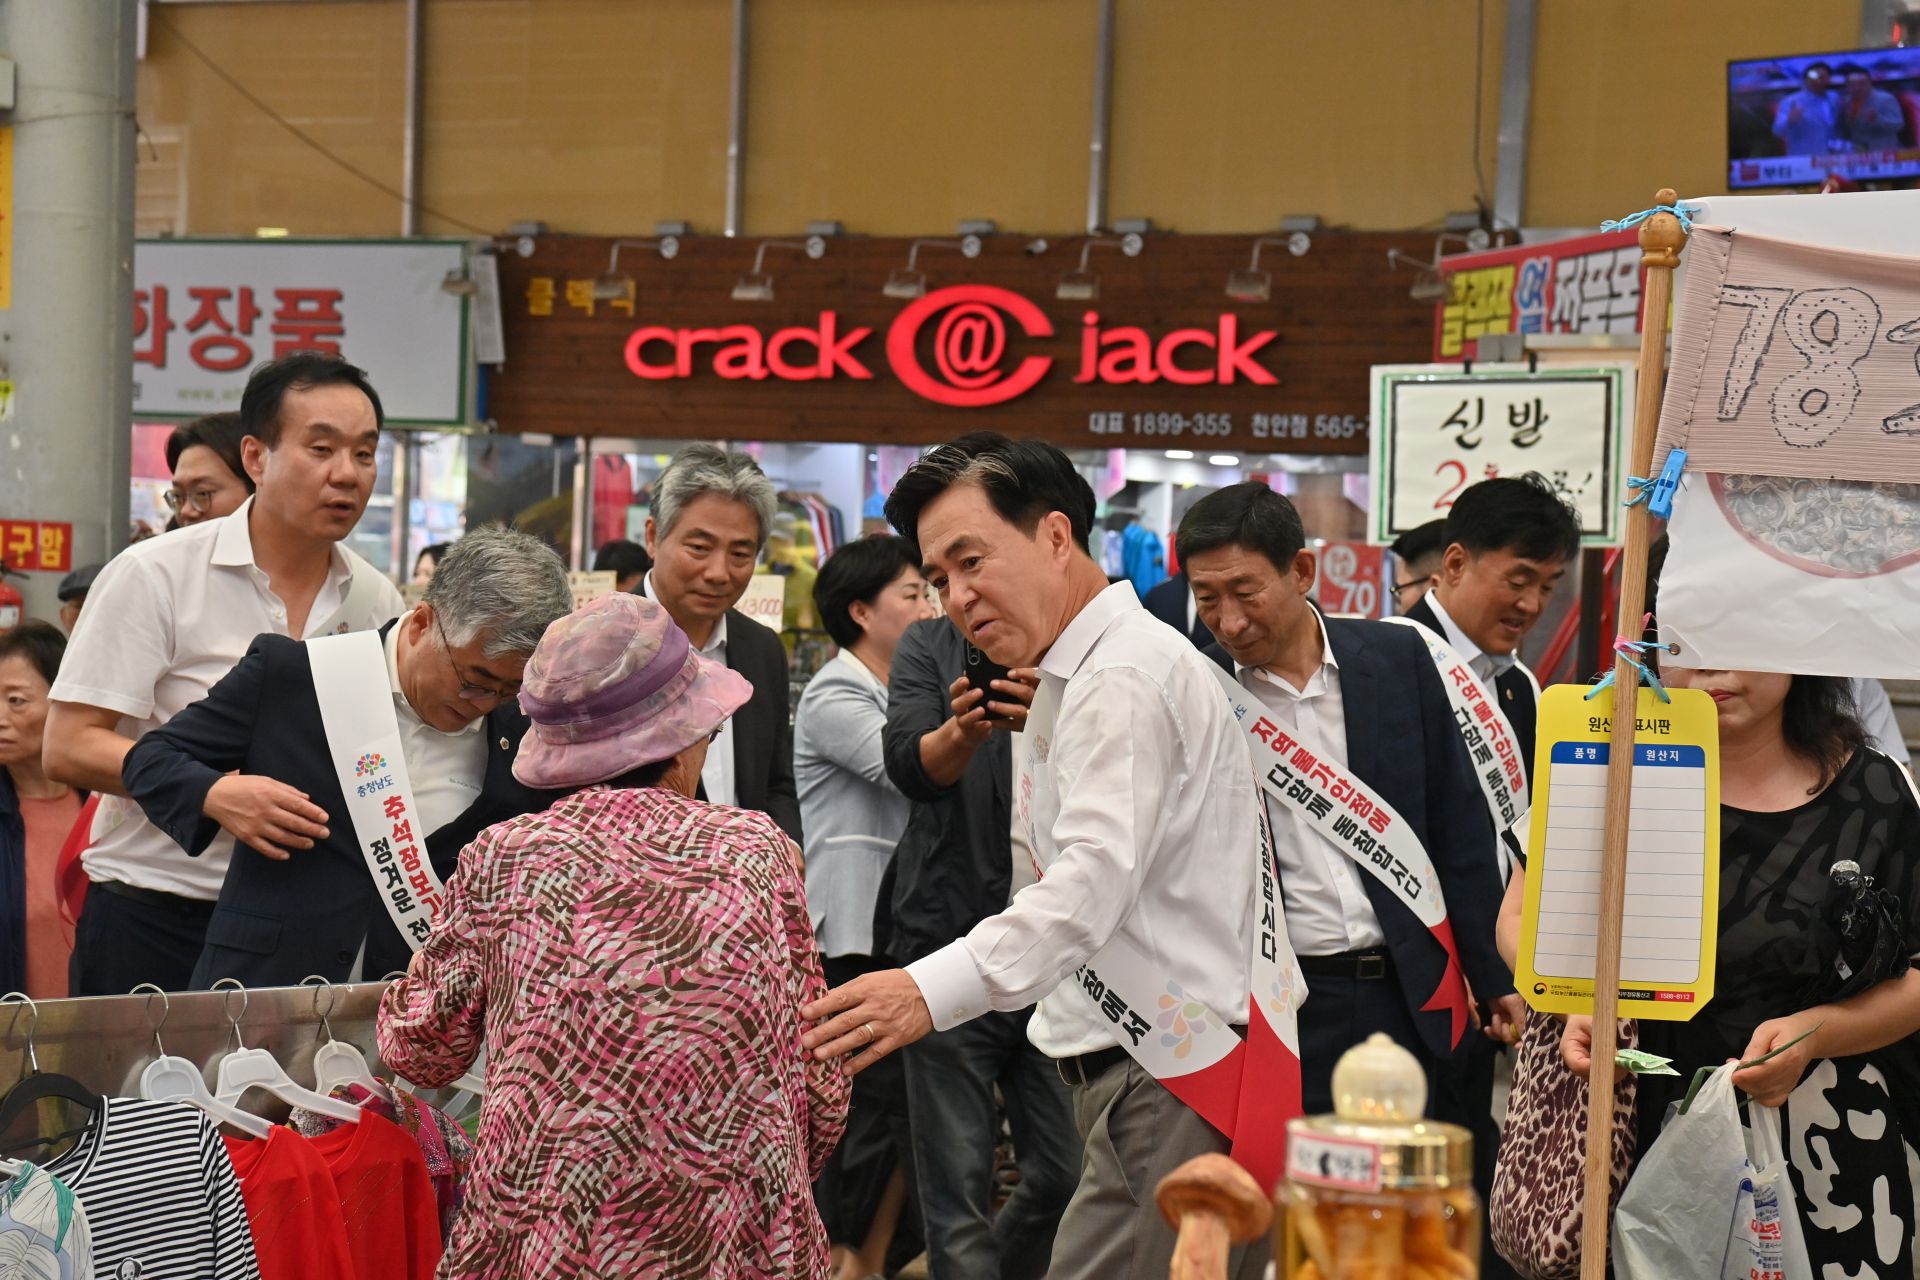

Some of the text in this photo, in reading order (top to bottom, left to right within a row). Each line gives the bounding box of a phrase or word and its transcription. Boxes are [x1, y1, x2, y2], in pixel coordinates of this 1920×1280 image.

[624, 311, 874, 380] crack
[1073, 310, 1280, 385] jack
[1088, 412, 1125, 434] 대표
[1252, 414, 1308, 439] 천안점
[0, 525, 64, 569] 구함
[1449, 664, 1524, 795] 지역물가안정에
[1574, 747, 1680, 762] 품명 원산지
[356, 774, 395, 798] 충청남도
[1250, 715, 1392, 834] 지역물가안정에
[1266, 763, 1423, 900] 다함께 동참합시다
[370, 836, 416, 915] 정겨운
